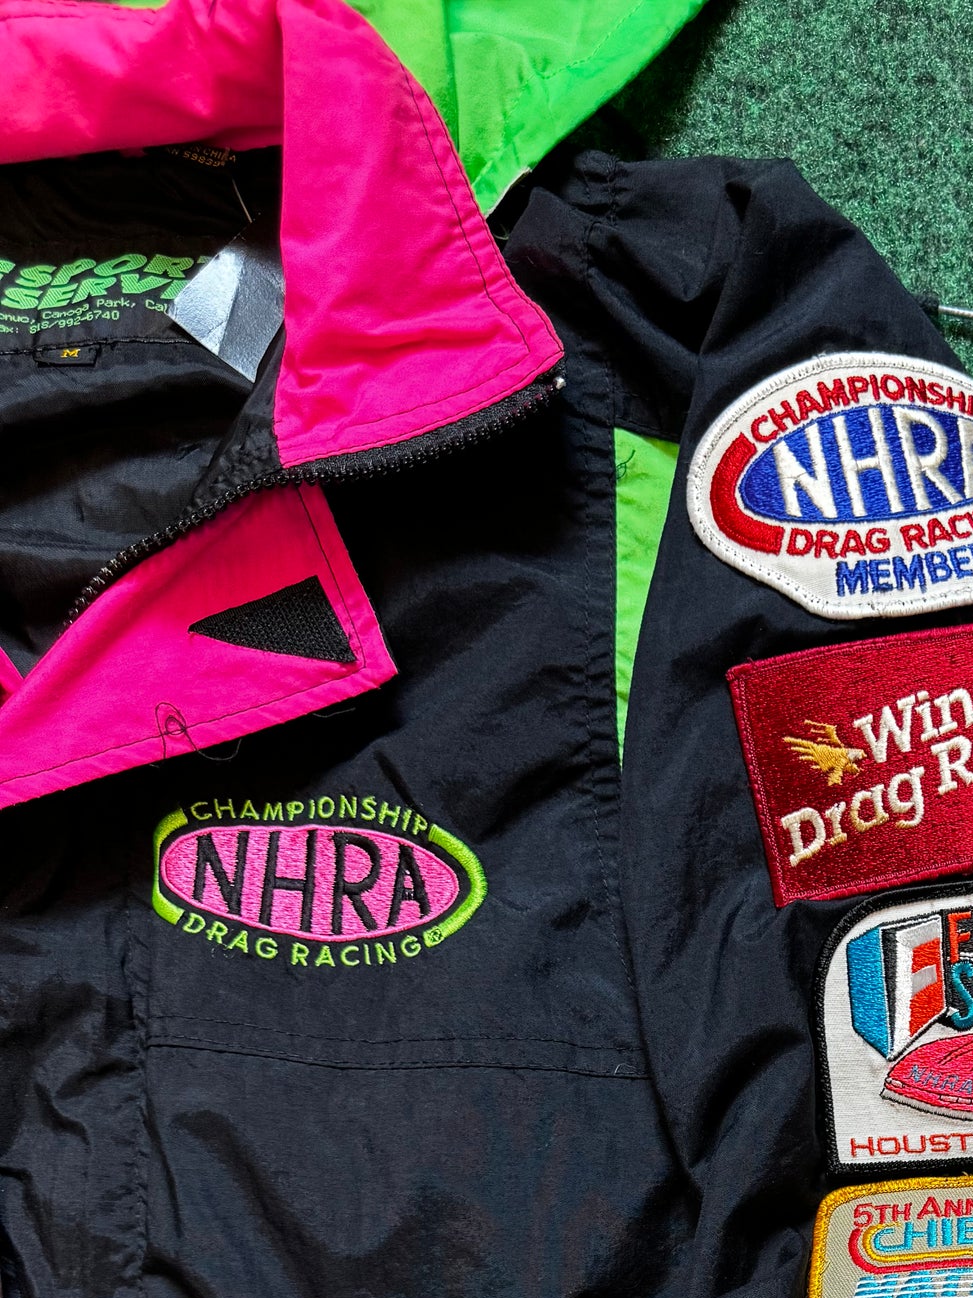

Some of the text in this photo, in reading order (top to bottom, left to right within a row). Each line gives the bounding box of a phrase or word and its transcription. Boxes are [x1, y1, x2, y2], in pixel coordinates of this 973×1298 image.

[15, 254, 213, 288] SPOR
[0, 310, 120, 335] ax: 818/992-6740
[42, 303, 91, 321] Canoga
[97, 297, 137, 309] Park,
[145, 299, 170, 315] Cal
[61, 349, 80, 358] M
[786, 527, 891, 559] DRAG
[190, 795, 428, 836] CHAMPIONSHIP
[780, 765, 925, 867] Drag
[192, 829, 433, 935] NHRA
[183, 912, 423, 968] DRAG RACING
[853, 1202, 911, 1228] 5TH
